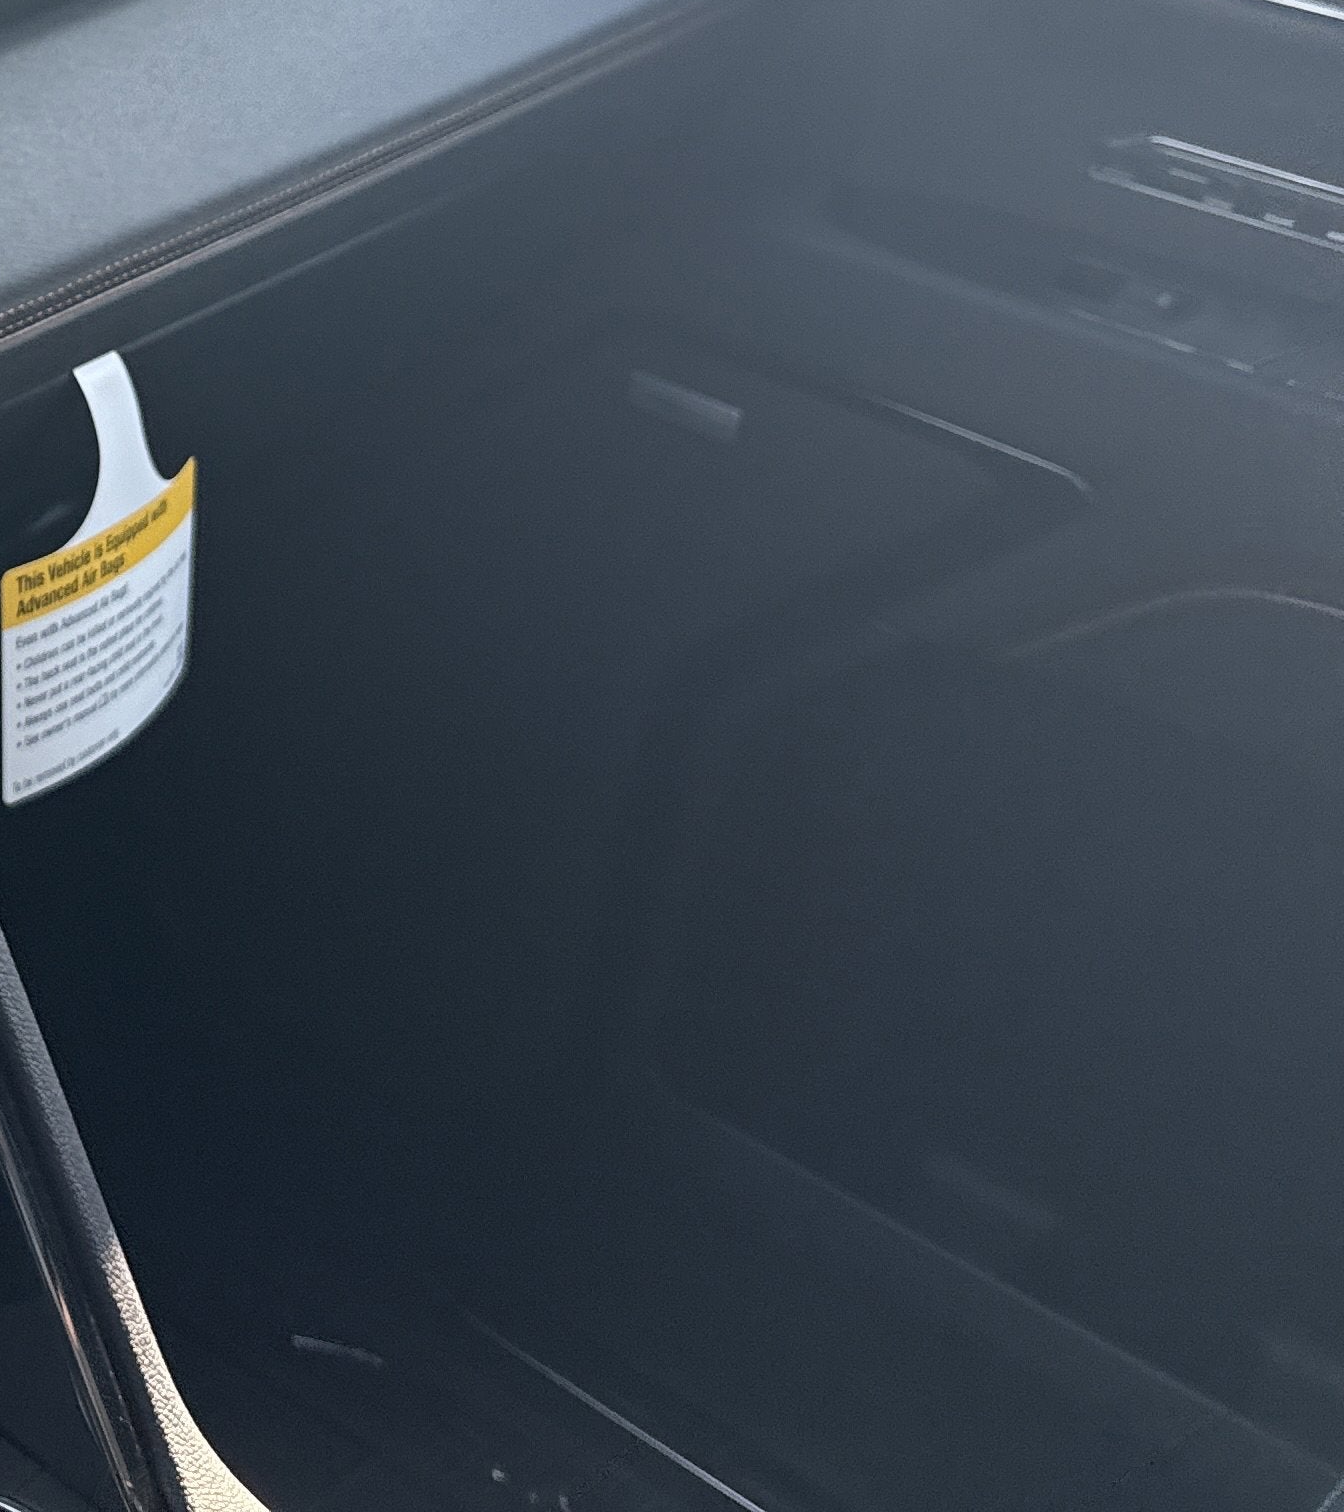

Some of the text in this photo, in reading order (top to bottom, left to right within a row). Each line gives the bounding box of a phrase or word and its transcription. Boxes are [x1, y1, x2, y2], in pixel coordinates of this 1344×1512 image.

[16, 498, 169, 594] This Vehicle is Equipped with
[16, 552, 126, 618] Advanced Air Bags
